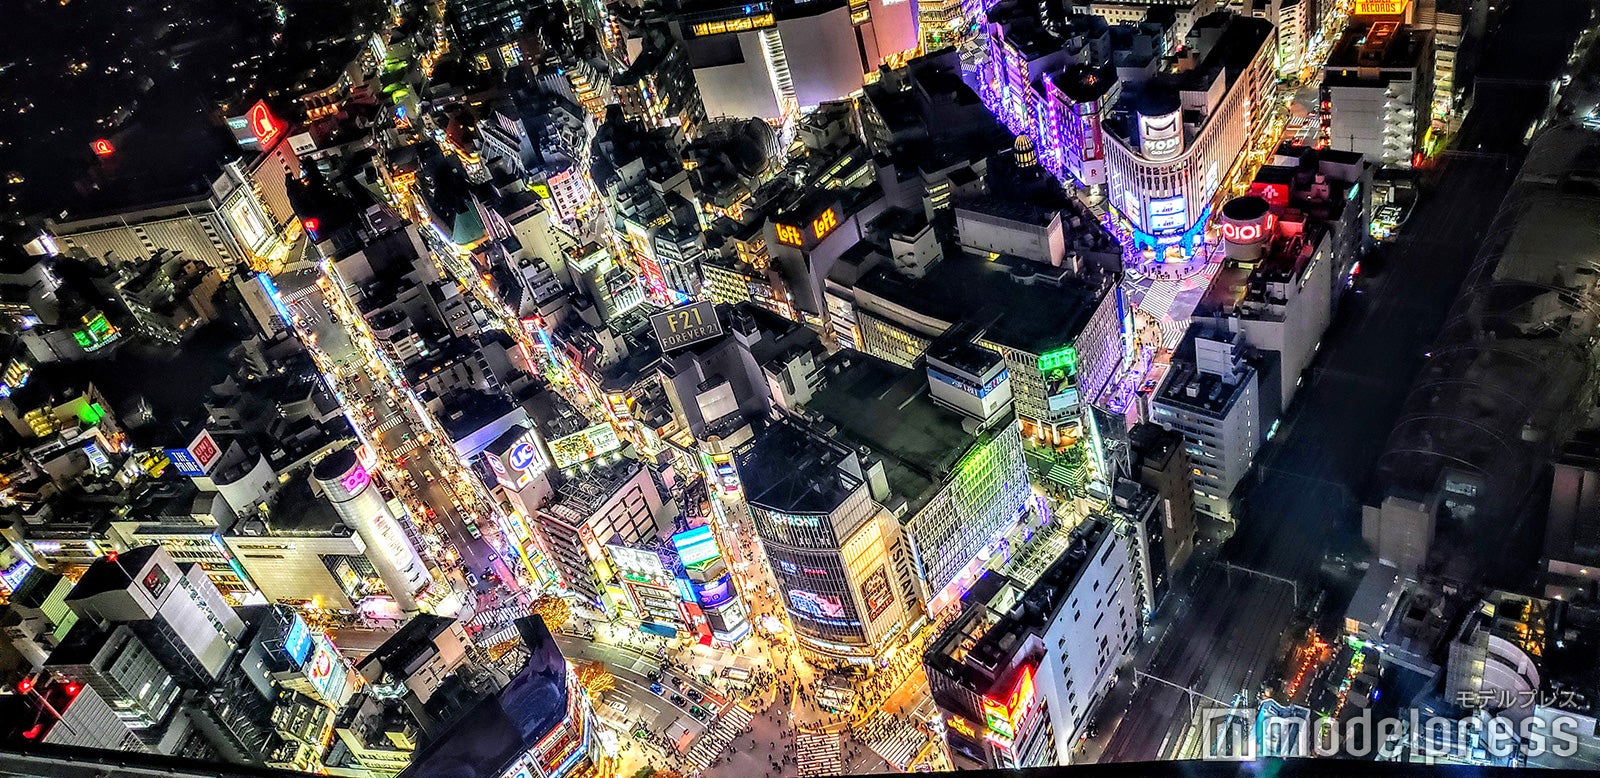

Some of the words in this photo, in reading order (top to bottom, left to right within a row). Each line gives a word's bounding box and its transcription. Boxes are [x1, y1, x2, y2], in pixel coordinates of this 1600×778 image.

[1361, 3, 1396, 12] RECORDS
[1144, 136, 1180, 151] MODI
[666, 307, 703, 333] F21
[661, 326, 706, 347] FOREVER
[706, 323, 719, 334] 21
[171, 451, 189, 462] THE
[889, 536, 917, 612] TSUTAYA
